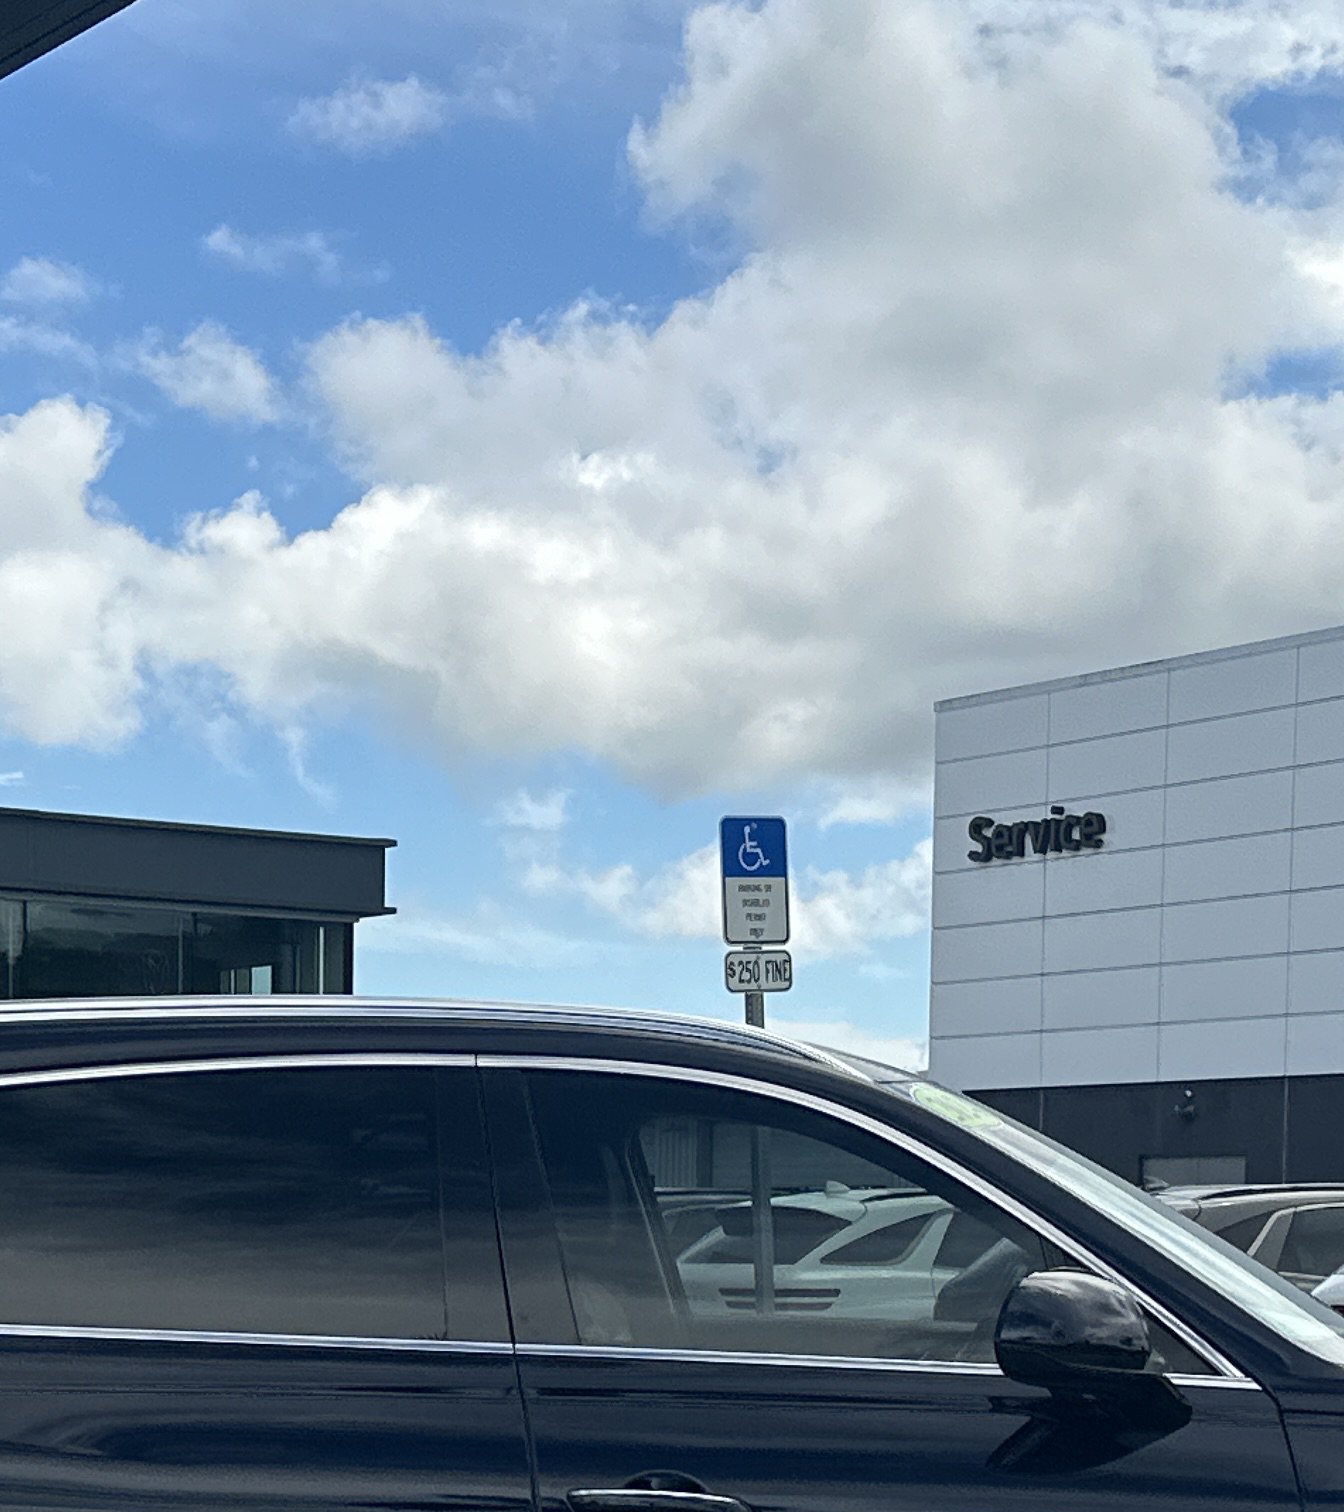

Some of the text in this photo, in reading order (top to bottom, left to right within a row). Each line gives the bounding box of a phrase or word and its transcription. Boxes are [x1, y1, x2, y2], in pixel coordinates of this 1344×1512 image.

[967, 805, 1107, 863] Service
[728, 959, 791, 984] $250 FINE
